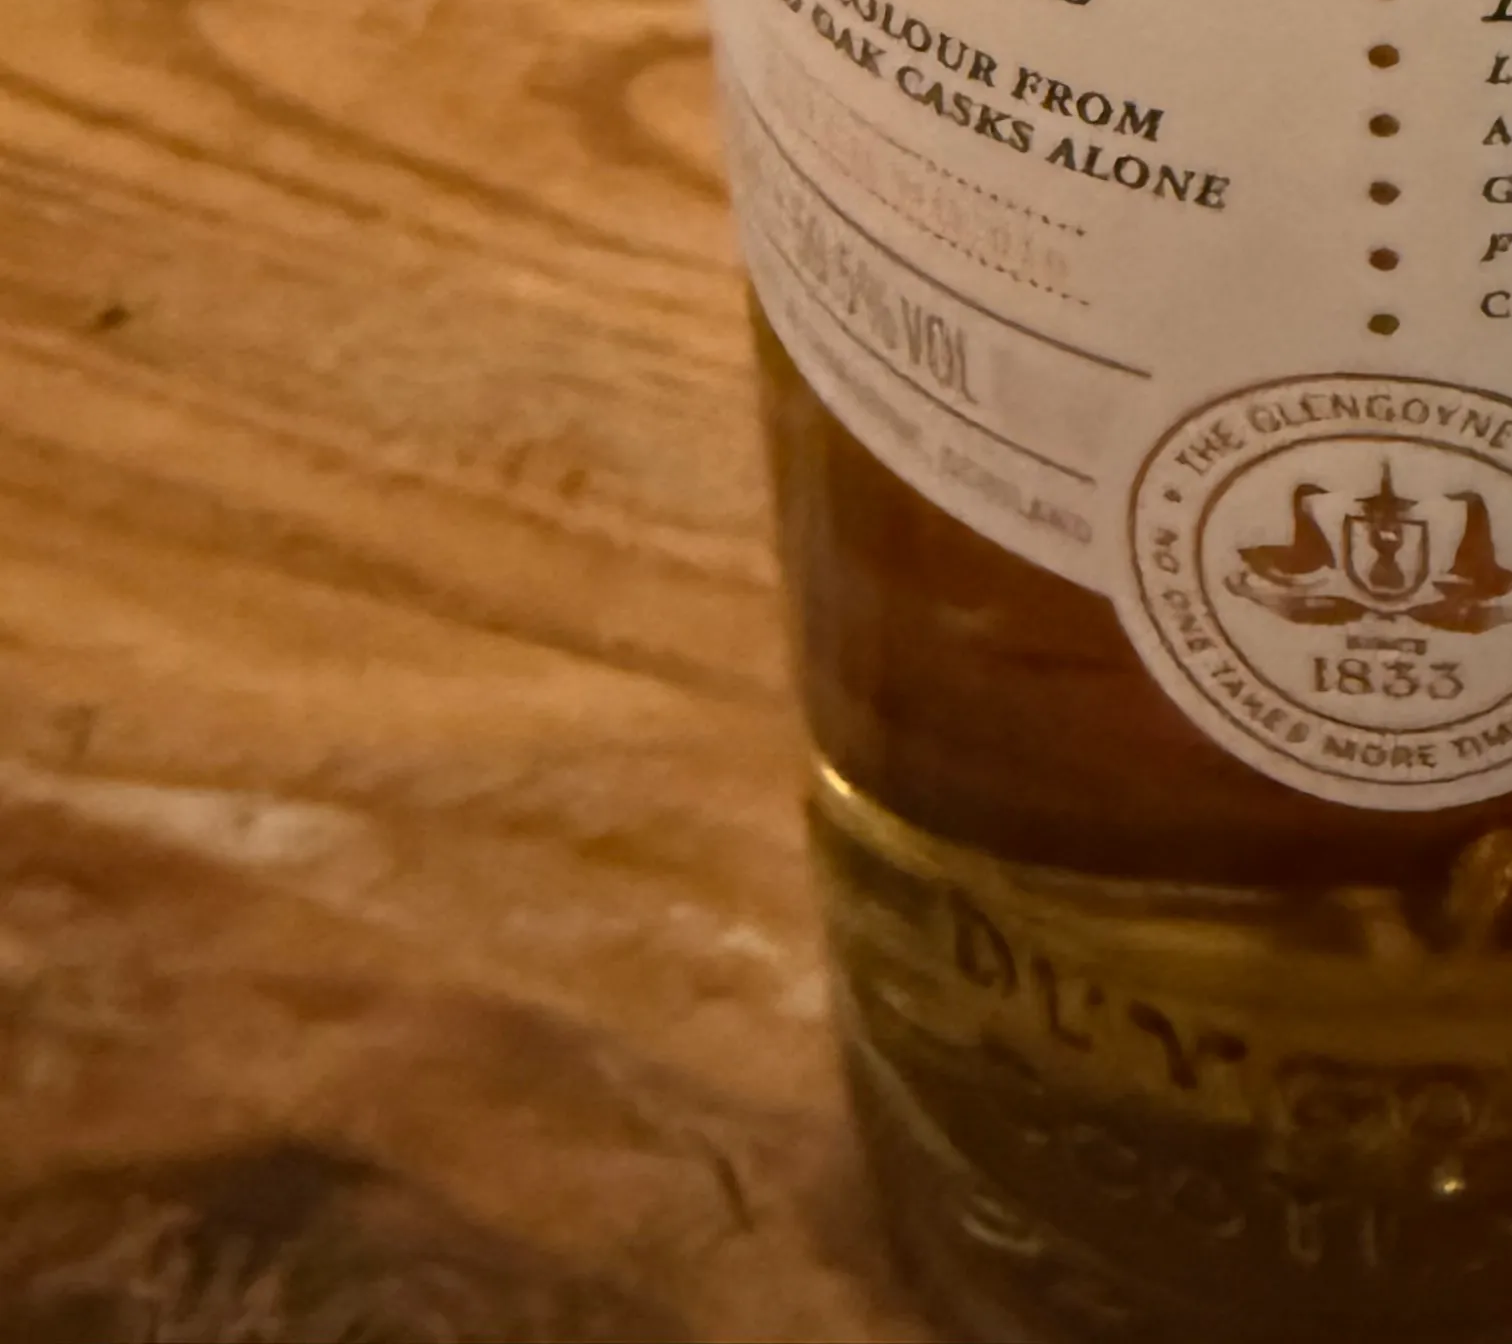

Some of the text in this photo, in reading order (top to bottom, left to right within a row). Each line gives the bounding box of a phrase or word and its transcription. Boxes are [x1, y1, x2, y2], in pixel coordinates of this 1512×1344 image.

[812, 4, 887, 78] OAK
[896, 63, 1035, 154] CASKS
[1045, 136, 1233, 212] ALONE
[1011, 64, 1165, 143] FROM
[900, 295, 979, 406] VOL
[1174, 415, 1245, 477] THE
[1151, 526, 1181, 576] NO
[1161, 588, 1216, 655] ONE
[1210, 658, 1312, 745] TAKES
[1312, 656, 1466, 701] 1833
[1321, 733, 1439, 770] MORE
